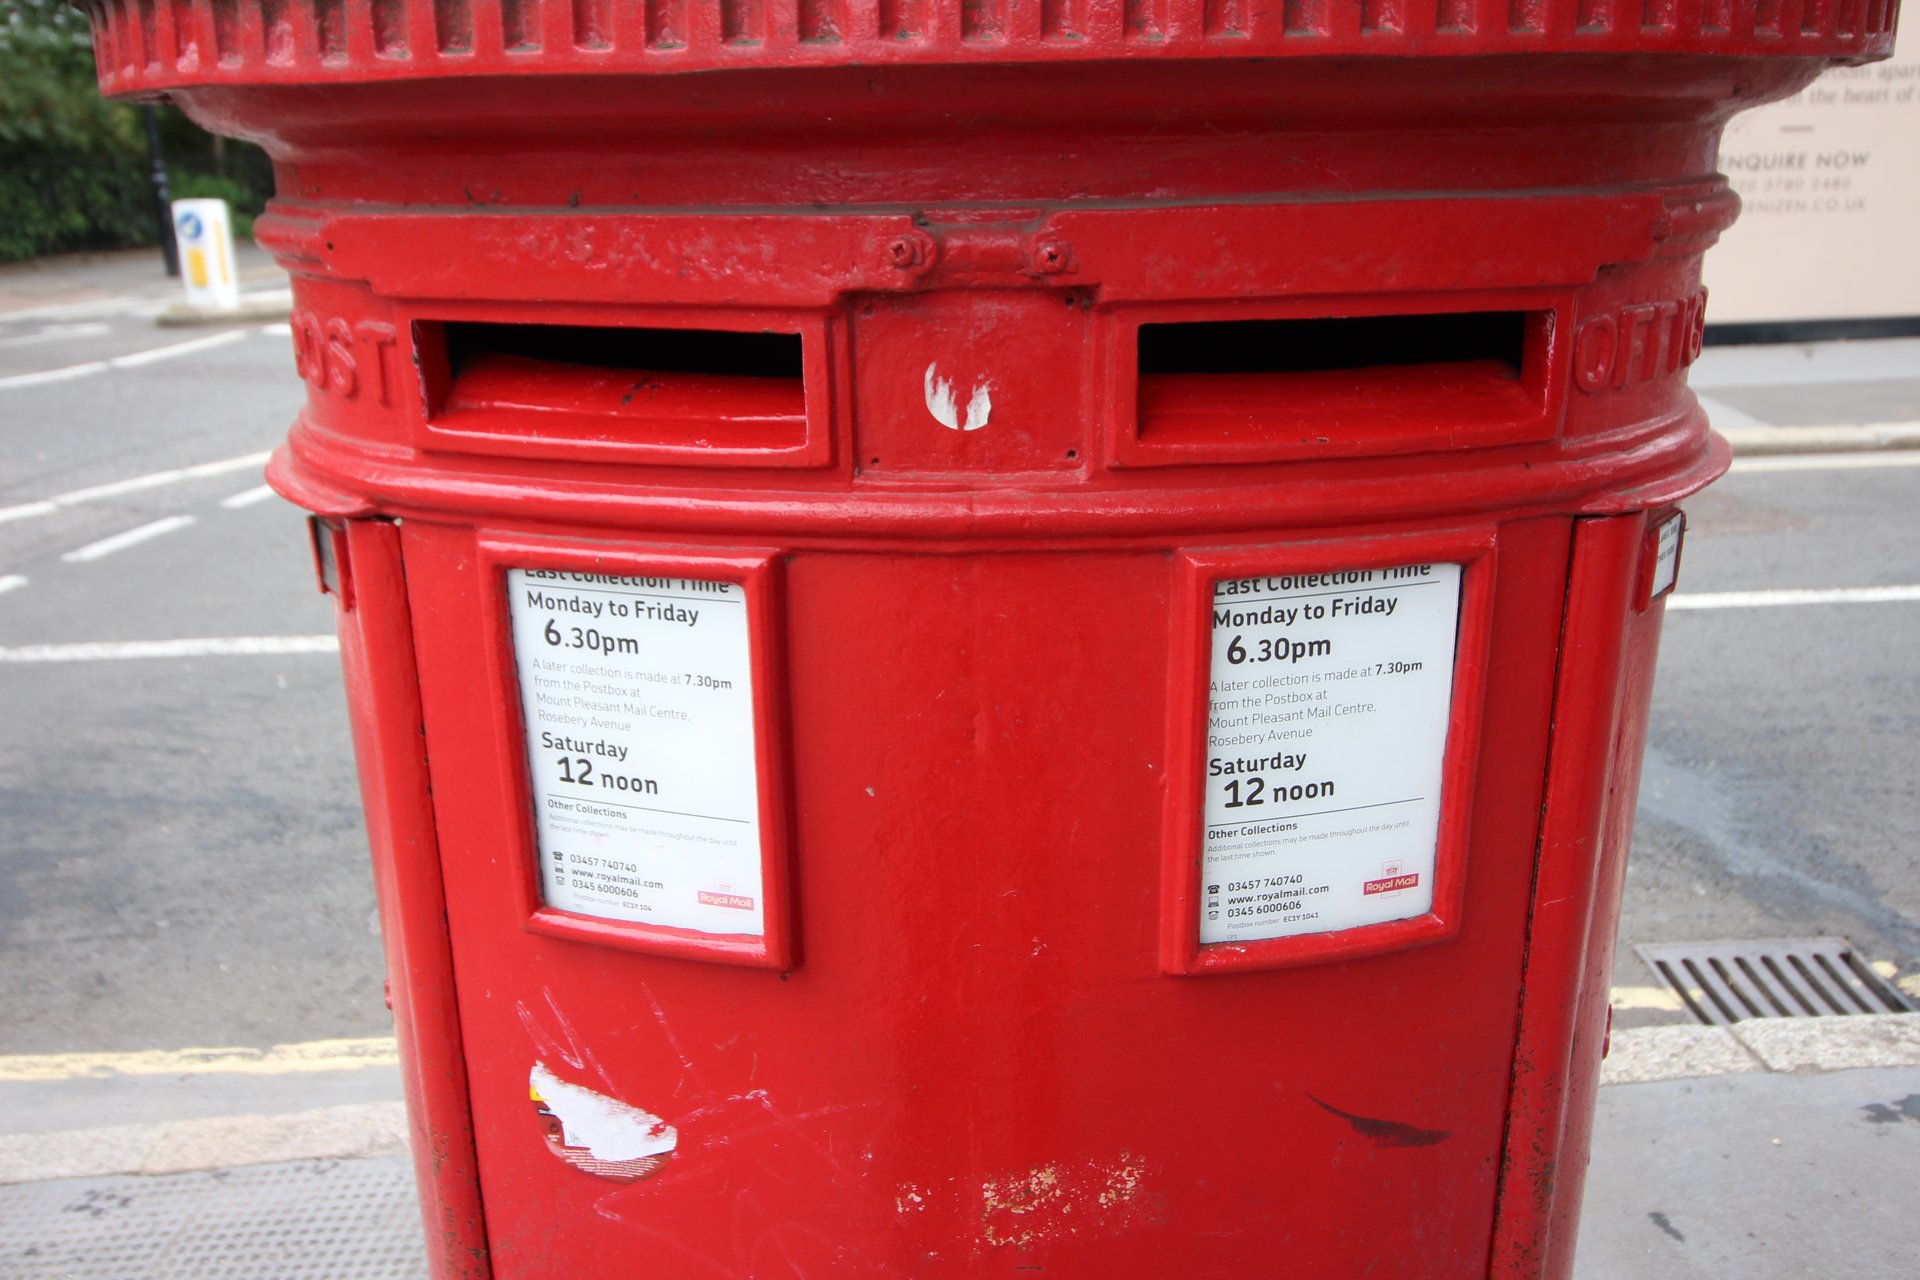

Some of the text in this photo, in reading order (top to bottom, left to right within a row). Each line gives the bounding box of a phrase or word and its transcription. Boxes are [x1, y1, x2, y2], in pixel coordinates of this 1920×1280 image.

[1810, 87, 1838, 104] the
[1843, 86, 1889, 104] heart
[1895, 84, 1915, 103] of
[1816, 149, 1871, 169] NOW
[526, 590, 699, 627] Monday to Friday
[1213, 597, 1398, 629] Monday to Friday
[544, 618, 639, 656] 6.30pm
[1227, 635, 1331, 665] 6.30pm
[532, 658, 732, 690] A later collection is made at 7.30pm
[1210, 661, 1423, 692] A later collection is made at 7.30pm
[534, 675, 641, 698] from the Postbox at
[536, 693, 572, 707] Mount
[574, 696, 621, 714] Pleasant
[623, 702, 647, 716] Mail
[1209, 689, 1328, 712] from the Postbox at
[538, 709, 631, 732] Rosebery Avenue
[1209, 714, 1249, 730] Mount
[1252, 708, 1304, 725] Pleasant
[1307, 706, 1332, 719] Mail
[541, 732, 628, 761] Saturday
[1209, 727, 1313, 748] Rosebery Avenue
[557, 756, 658, 794] 12 noon
[1209, 752, 1307, 777] Saturday
[1223, 777, 1335, 809] 12 noon
[547, 799, 628, 819] Other Collections
[1207, 819, 1410, 853] Additional collections may be made throughout the day until
[1208, 821, 1298, 840] Other Collections
[570, 854, 637, 873] 03457 740740
[1207, 853, 1220, 863] the
[1220, 851, 1234, 861] last
[1234, 850, 1251, 860] time
[571, 869, 664, 890] www.royalmail.com
[572, 879, 638, 898] 0345 6000606
[1228, 874, 1303, 892] 03457 740740
[1366, 875, 1416, 892] Royal Mail
[700, 892, 752, 908] Royal Mail
[1227, 883, 1330, 906] www.royalmail.com
[1227, 900, 1302, 918] 0345 6000606
[1227, 920, 1253, 930] Postbox
[1254, 917, 1280, 927] number
[1283, 914, 1301, 923] EC1Y
